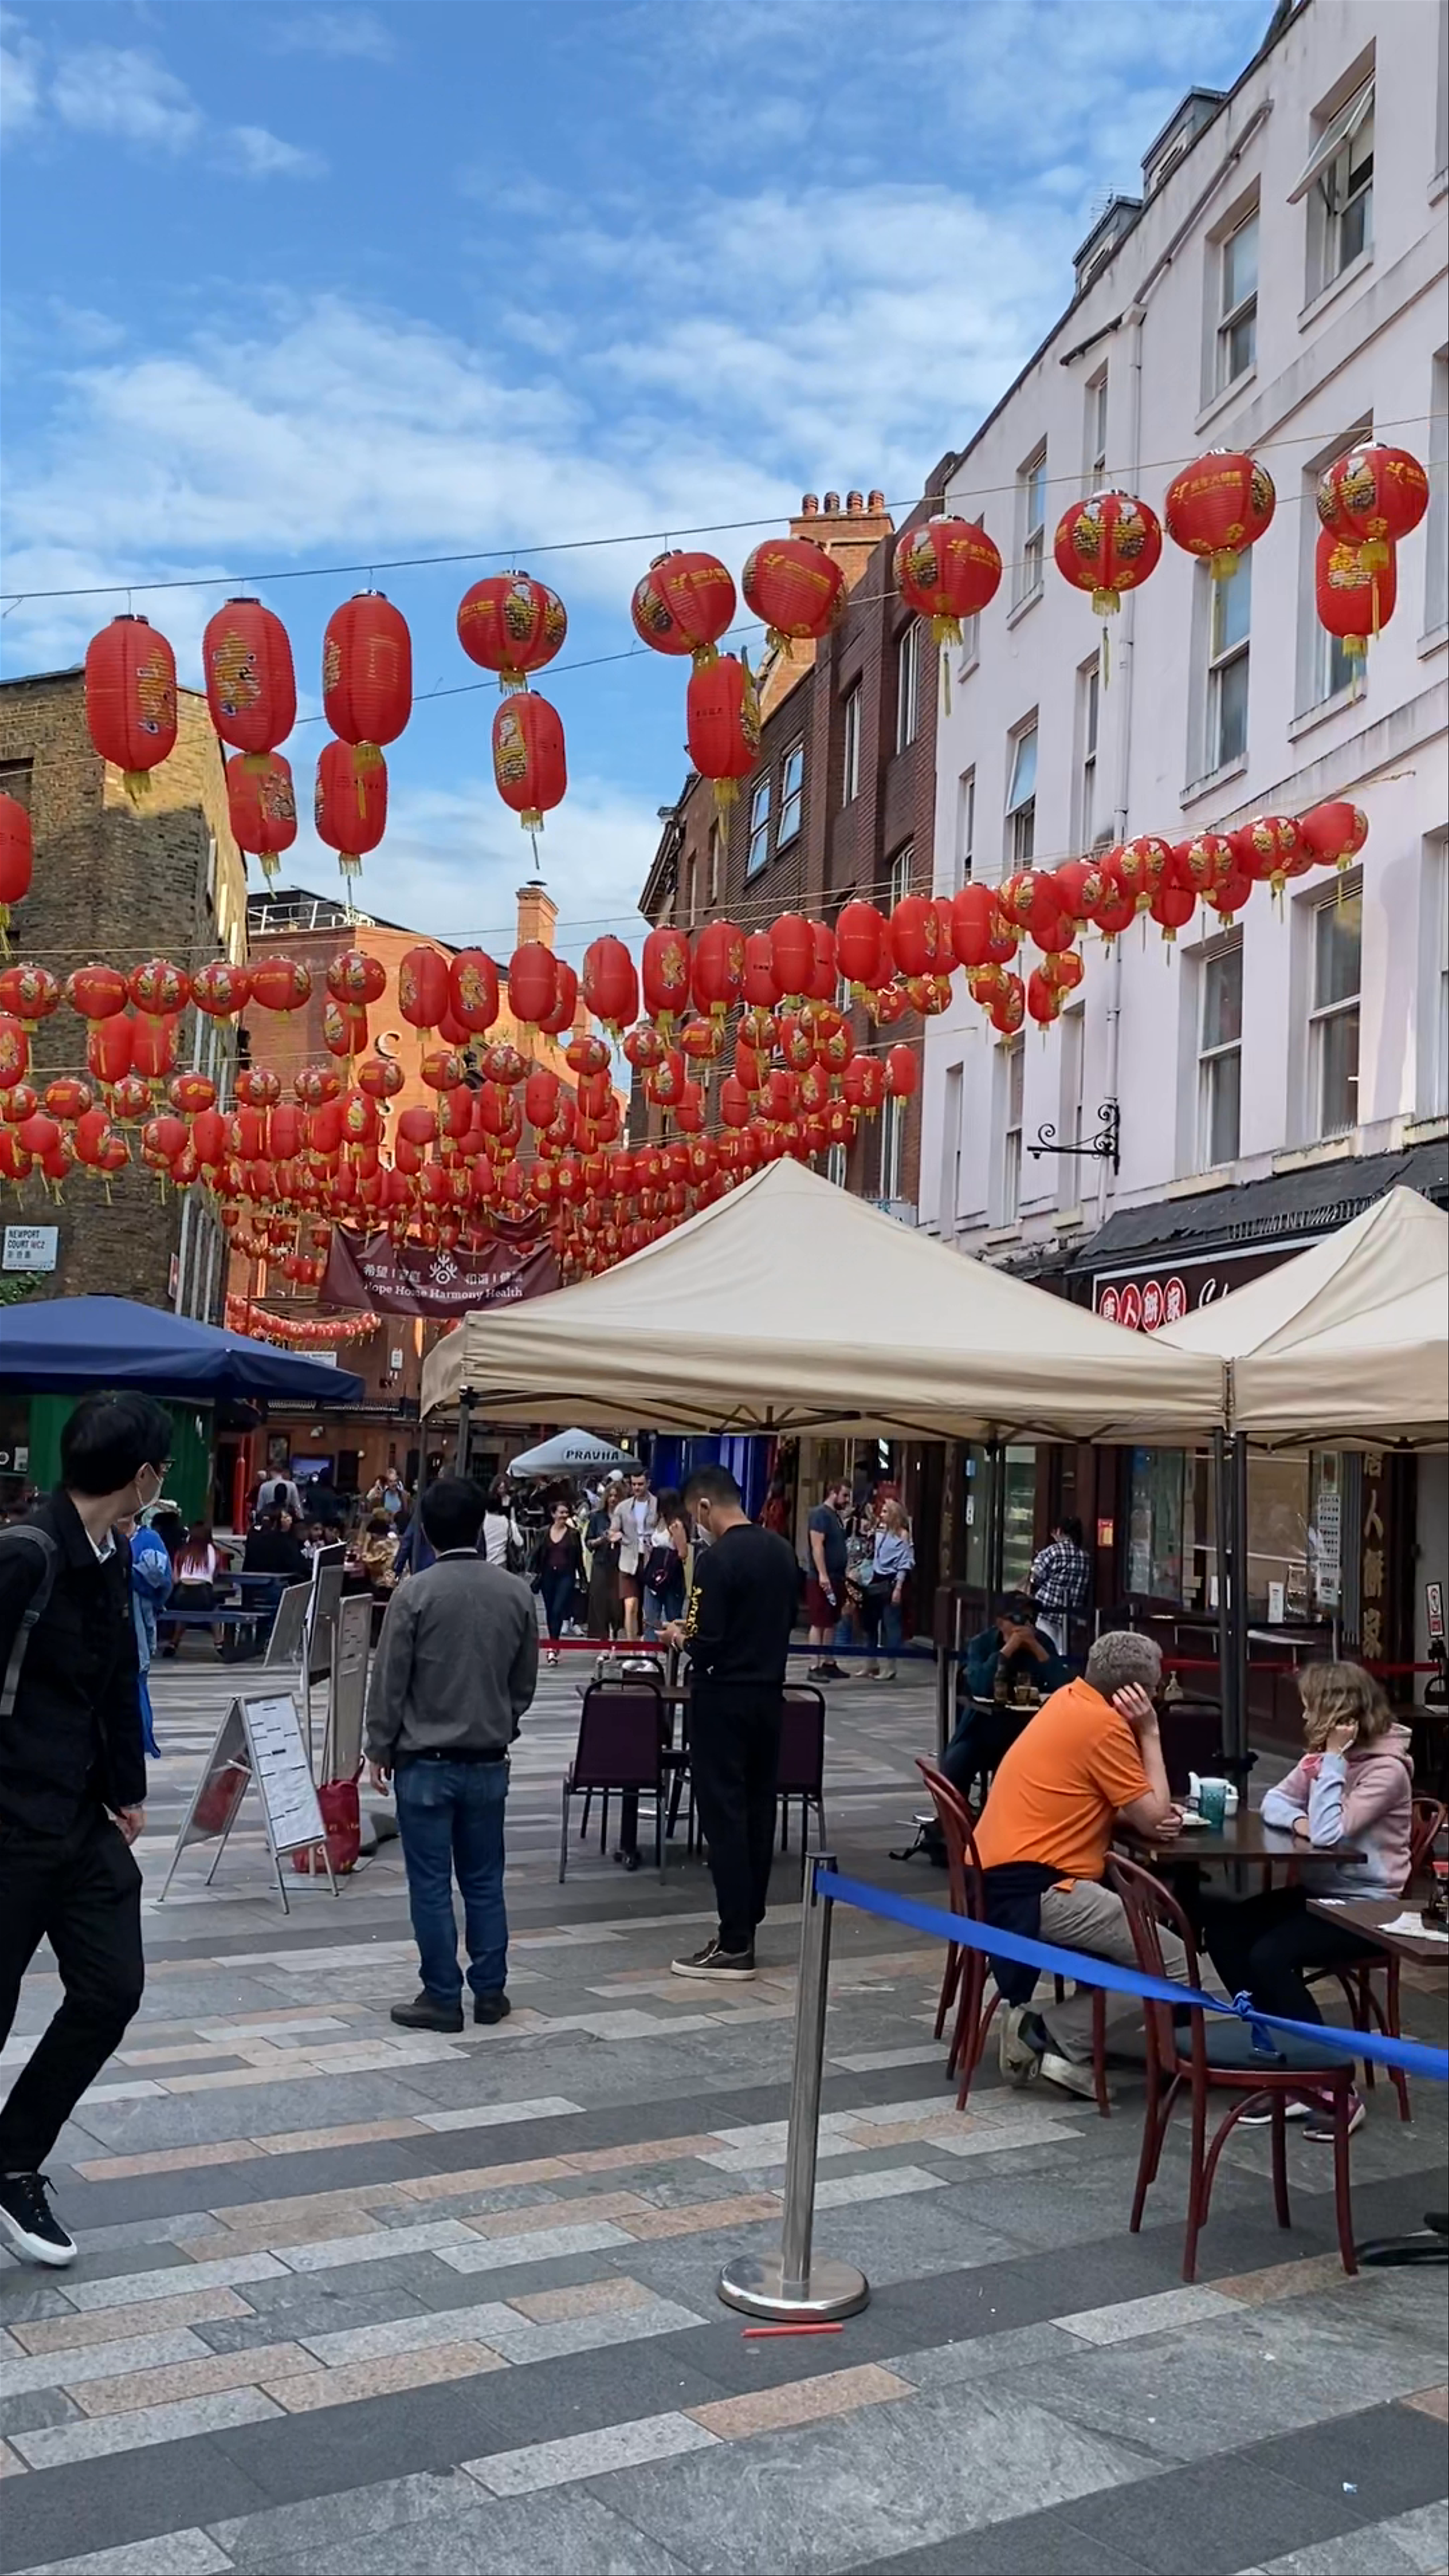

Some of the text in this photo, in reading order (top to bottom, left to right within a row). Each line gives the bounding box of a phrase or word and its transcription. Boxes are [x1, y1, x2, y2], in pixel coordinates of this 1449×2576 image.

[9, 1230, 40, 1238] NEWPORT
[8, 1240, 45, 1249] COURT WC2
[429, 1288, 483, 1300] Harmony
[486, 1287, 523, 1297] Health
[566, 1450, 619, 1461] PRAVHA
